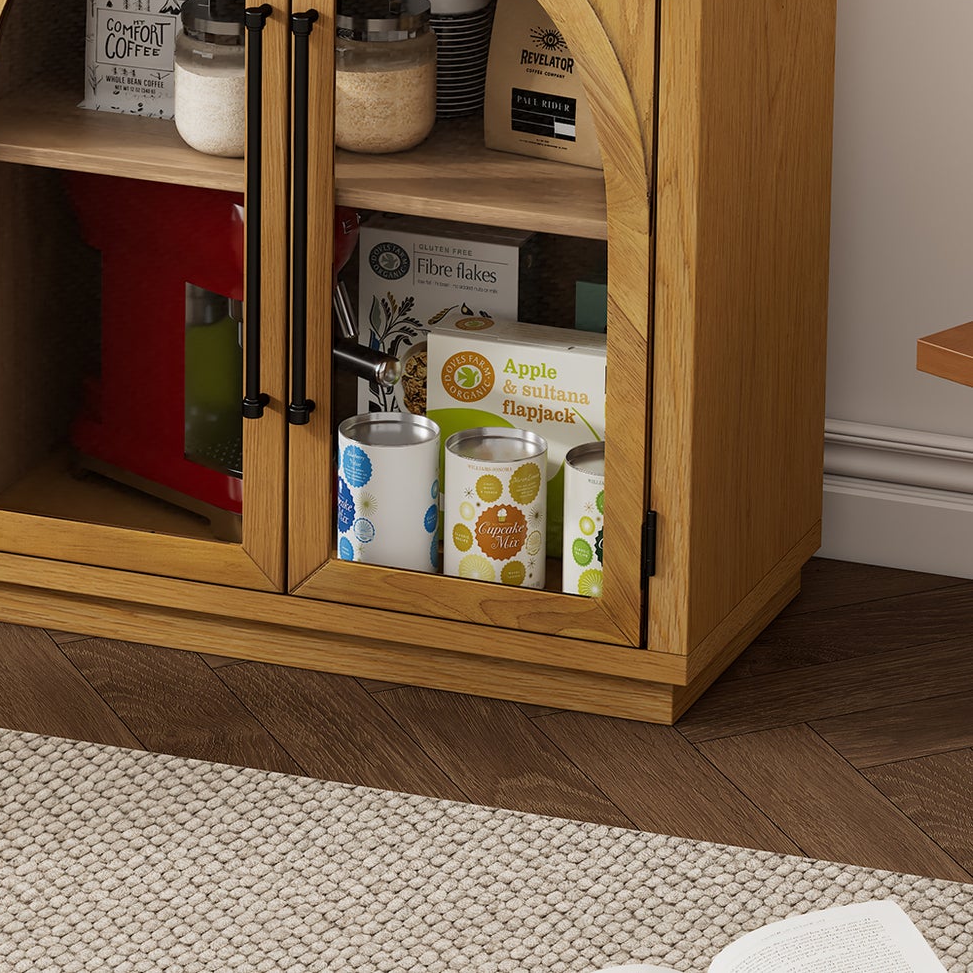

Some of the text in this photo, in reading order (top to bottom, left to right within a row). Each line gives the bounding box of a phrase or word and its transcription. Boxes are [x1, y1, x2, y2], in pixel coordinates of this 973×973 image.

[107, 17, 171, 47] COMFORT
[105, 32, 161, 59] COFFEE
[520, 49, 575, 74] REVELATOR
[106, 75, 164, 89] WHOLE BEAN COFFEE
[544, 71, 565, 79] COMPANY
[418, 243, 473, 256] GLUTEN FREE
[417, 257, 497, 283] Fibre flakes
[445, 354, 491, 381] DOVES FARM
[503, 358, 558, 381] Apple
[449, 380, 491, 400] ORGANIC
[502, 379, 590, 405] & sultana
[502, 400, 576, 424] flapjack
[478, 522, 525, 537] Cupcake
[491, 535, 519, 549] Mix
